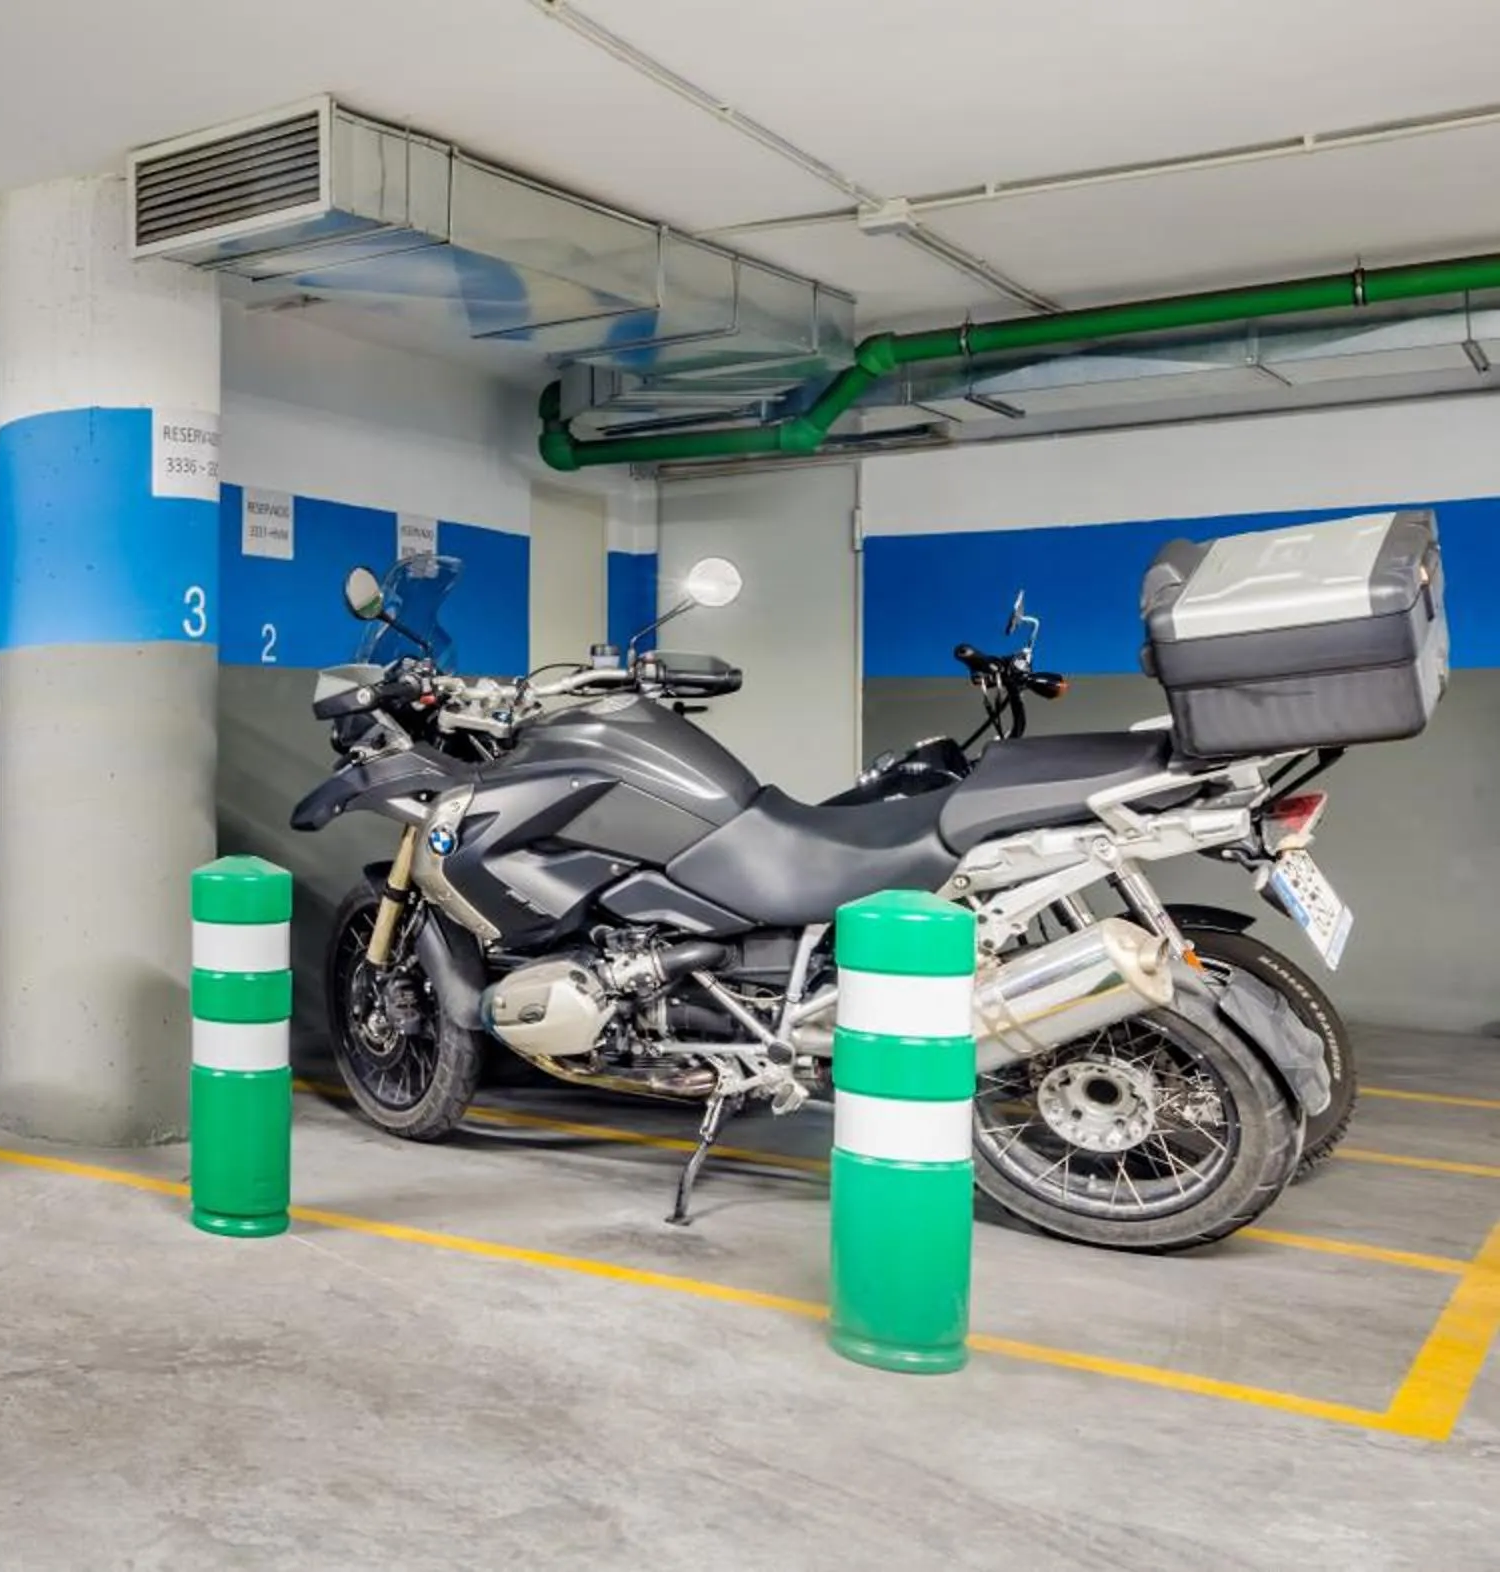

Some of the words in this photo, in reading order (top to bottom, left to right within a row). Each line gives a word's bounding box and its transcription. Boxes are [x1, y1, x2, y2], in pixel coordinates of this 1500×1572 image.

[165, 457, 197, 475] 3336
[182, 586, 206, 637] 3
[261, 623, 277, 663] 2
